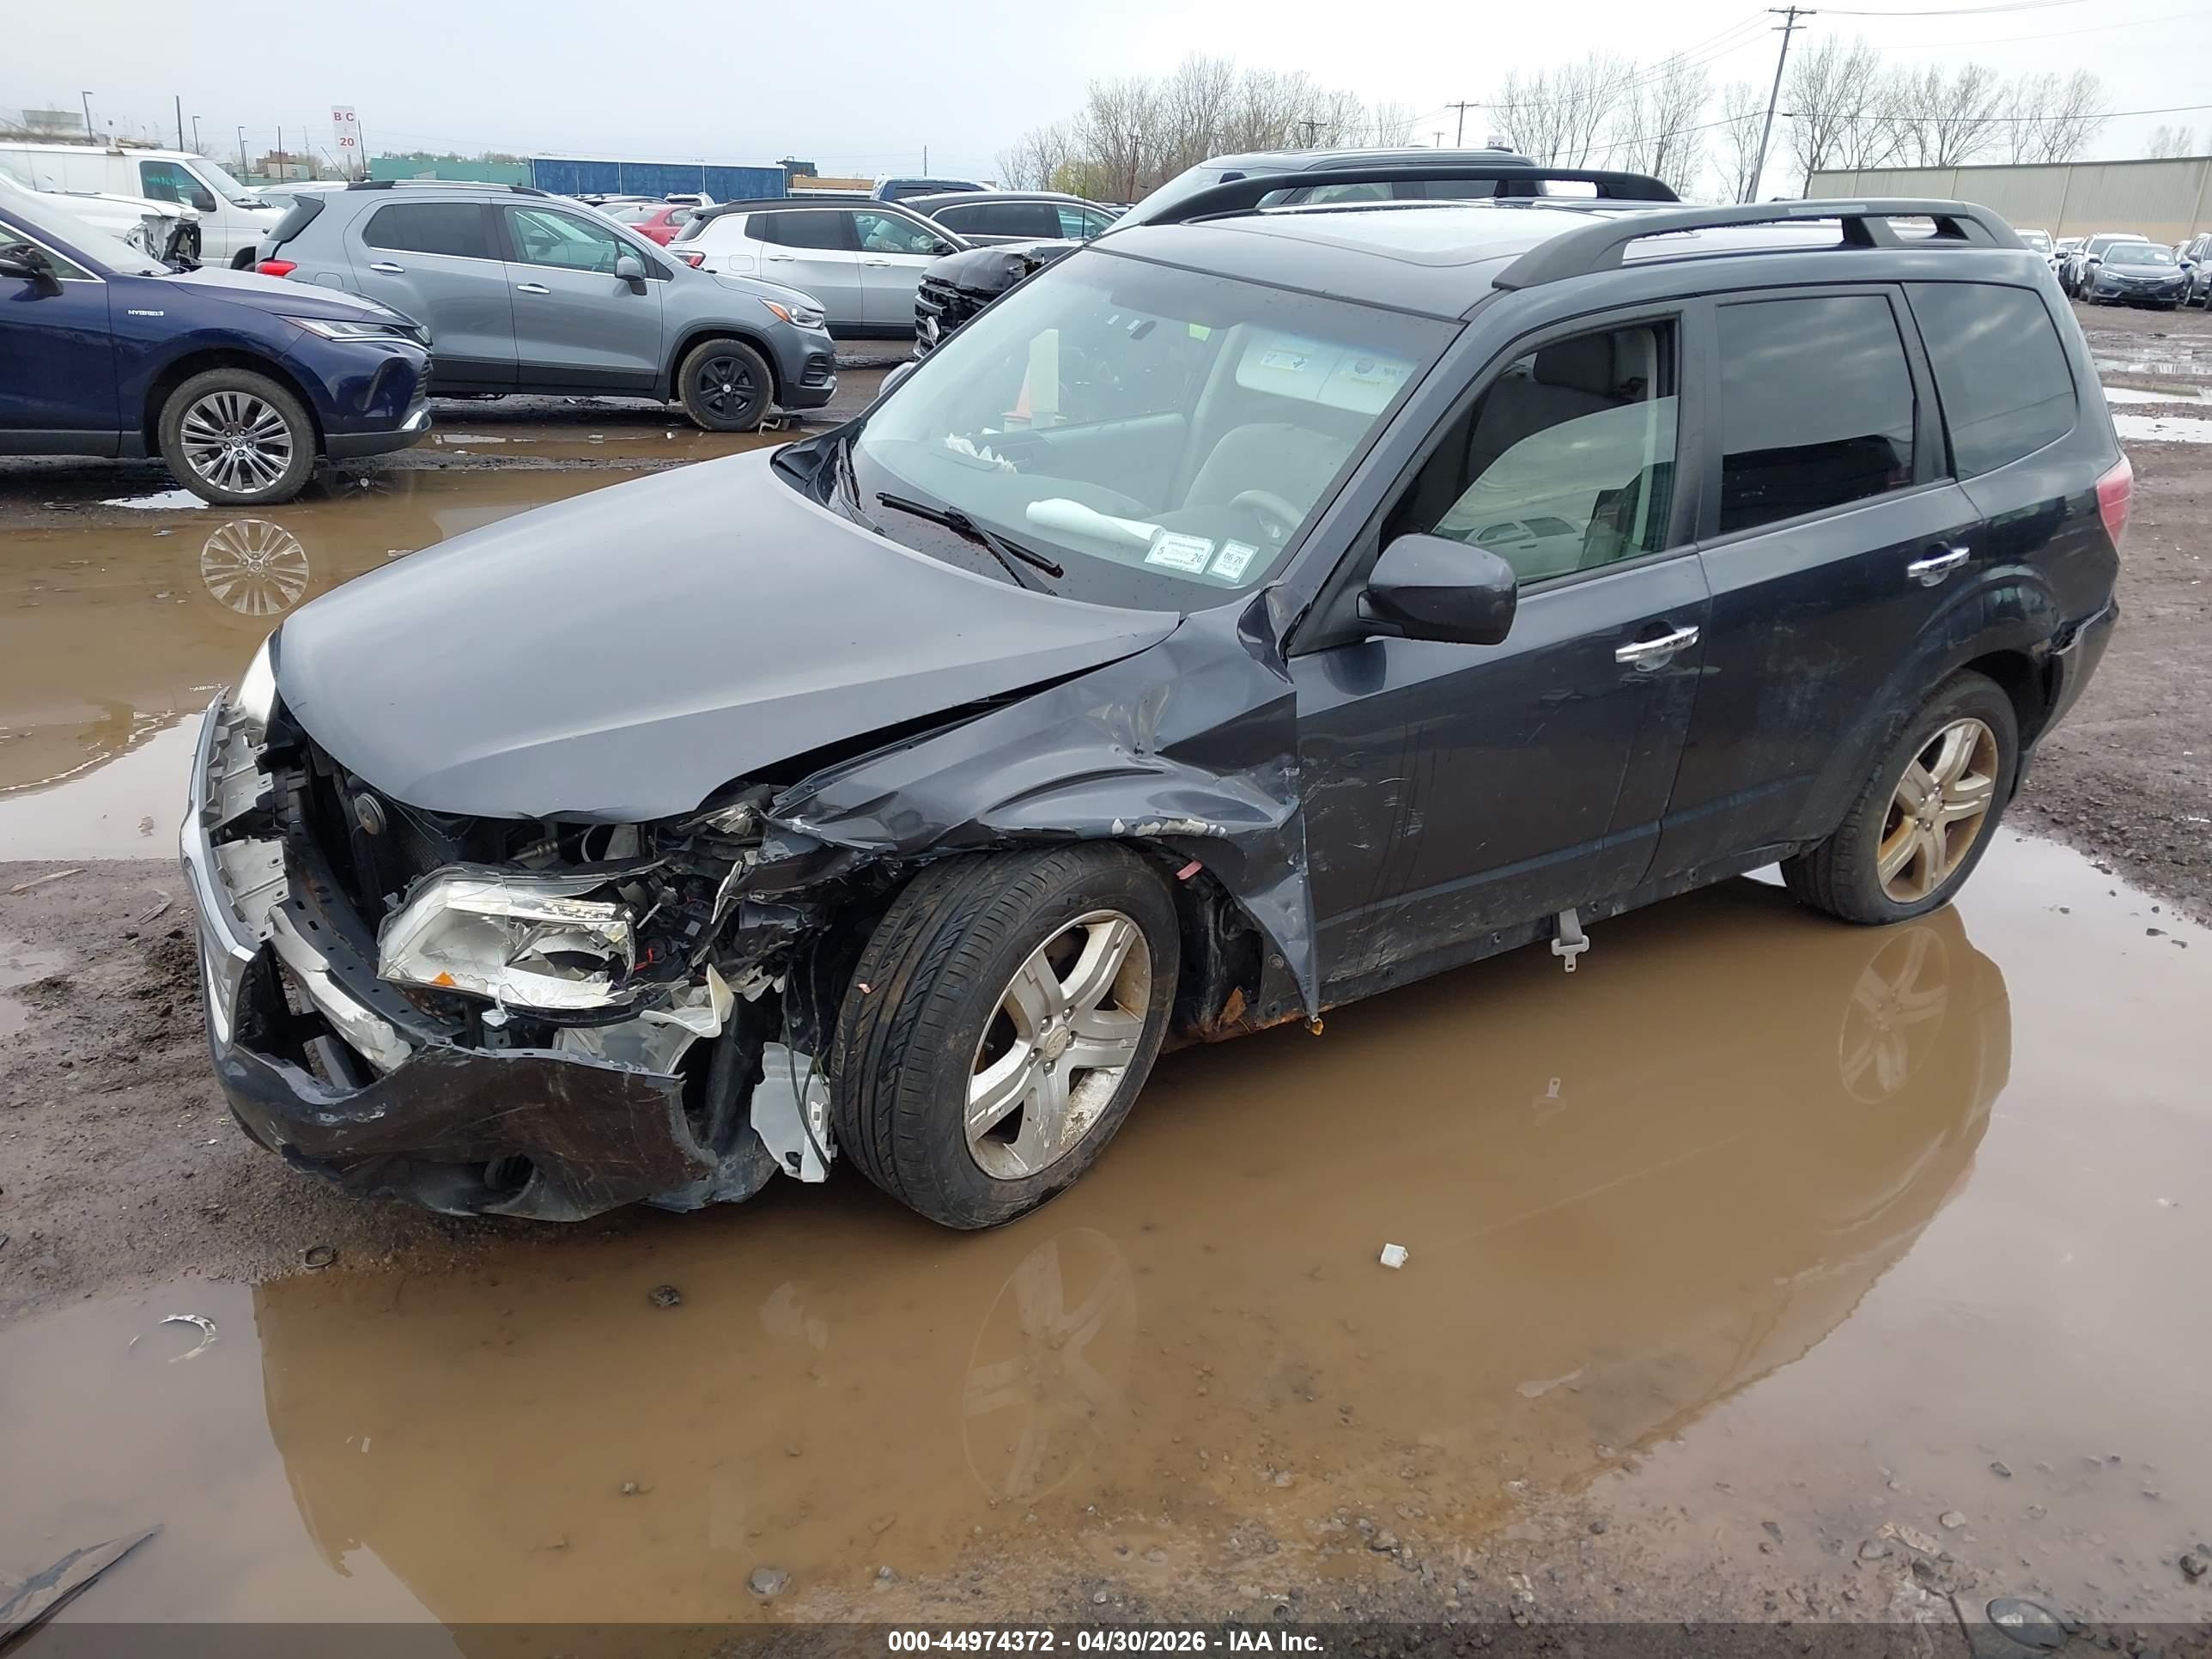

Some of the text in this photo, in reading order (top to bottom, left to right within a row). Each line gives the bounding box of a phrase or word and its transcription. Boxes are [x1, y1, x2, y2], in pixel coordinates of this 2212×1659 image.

[333, 112, 355, 122] B C
[339, 137, 355, 147] 20
[1191, 552, 1204, 563] 26
